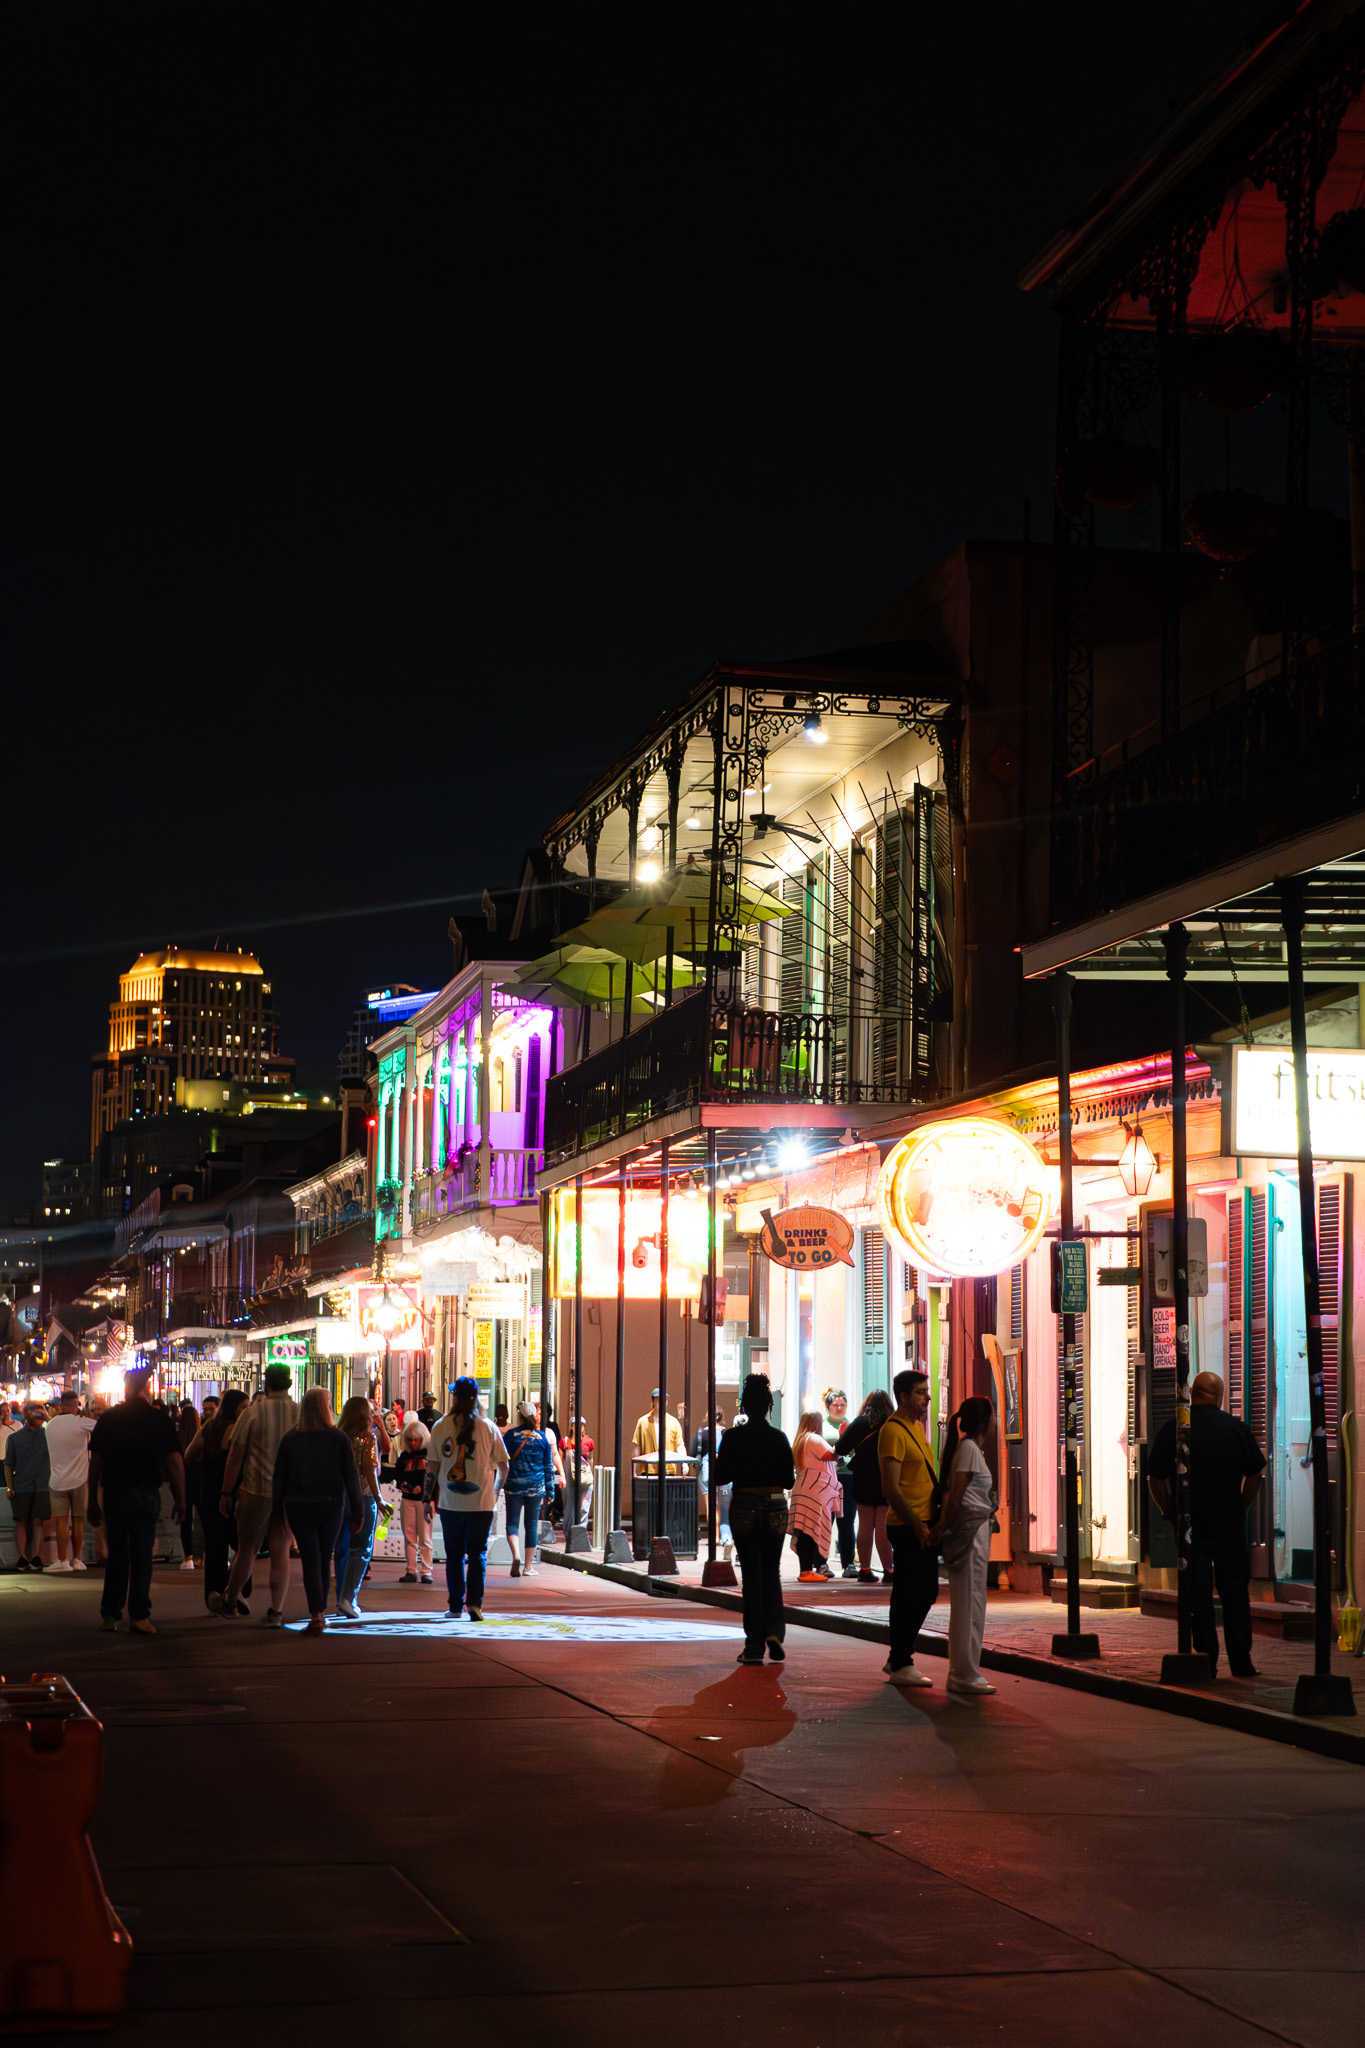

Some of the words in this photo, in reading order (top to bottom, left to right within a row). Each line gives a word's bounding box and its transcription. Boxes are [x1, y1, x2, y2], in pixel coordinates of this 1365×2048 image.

[784, 1228, 828, 1238] DRINKS
[786, 1238, 796, 1247] &
[798, 1237, 827, 1247] BEER
[788, 1250, 807, 1264] TO
[811, 1249, 832, 1263] GO
[361, 1306, 418, 1337] HAT
[1153, 1310, 1170, 1322] COLD
[1153, 1323, 1170, 1334] BEER
[271, 1344, 307, 1358] CATS
[476, 1347, 491, 1358] 50%
[1153, 1343, 1170, 1355] HAND
[478, 1359, 489, 1368] OFF
[1154, 1354, 1176, 1367] GRENADE
[189, 1367, 234, 1381] PRESERVATIN
